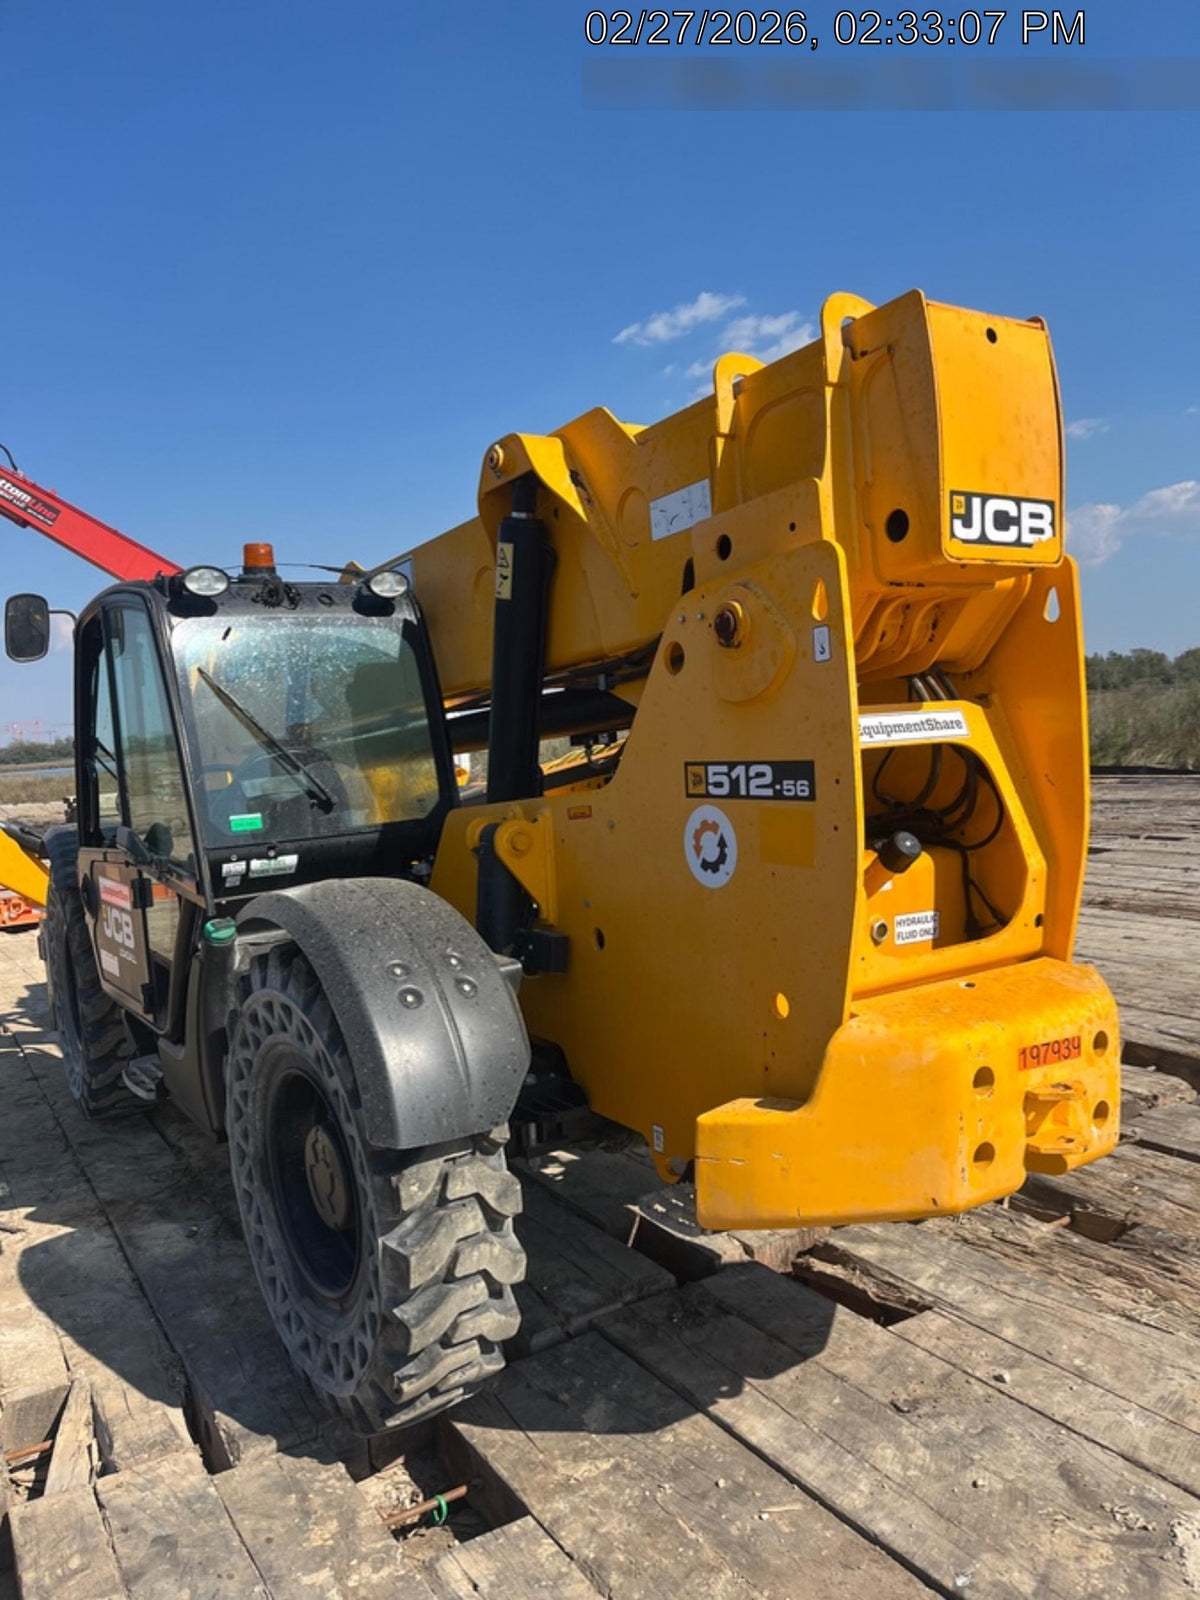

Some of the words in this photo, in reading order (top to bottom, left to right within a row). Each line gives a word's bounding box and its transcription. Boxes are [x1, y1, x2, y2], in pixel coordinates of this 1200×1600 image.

[952, 496, 1054, 544] JCB
[103, 906, 135, 950] JCB
[896, 912, 939, 928] HYDRAULIC
[897, 929, 918, 941] FLUID
[919, 926, 939, 938] ONLY
